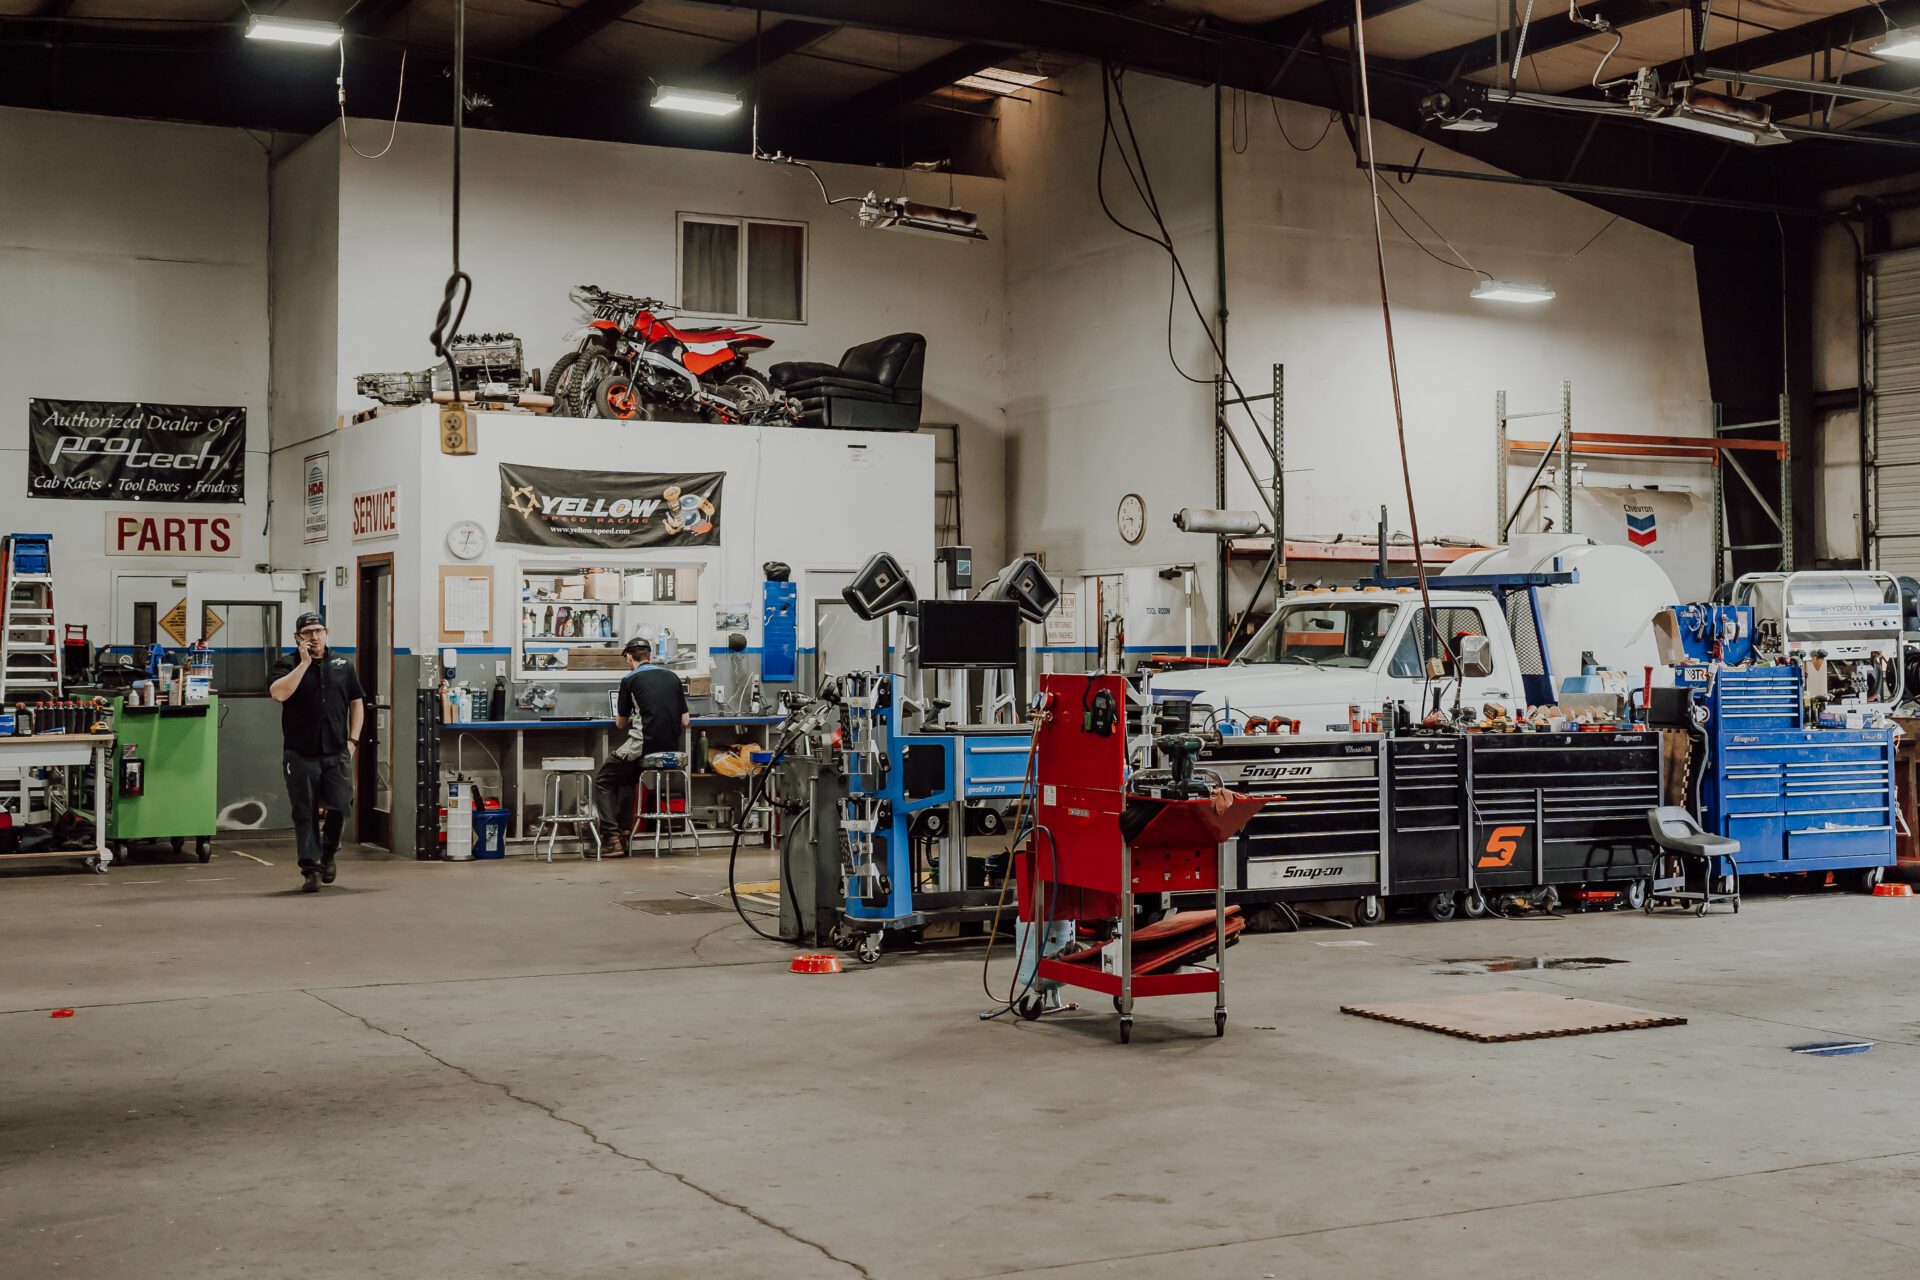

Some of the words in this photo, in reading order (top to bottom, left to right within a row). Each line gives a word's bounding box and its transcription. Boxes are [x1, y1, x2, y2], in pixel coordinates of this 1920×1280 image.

[43, 411, 144, 430] Authorized
[147, 415, 203, 432] Dealer
[207, 416, 236, 436] Of
[34, 475, 60, 489] Cab
[63, 476, 103, 490] Racks
[118, 478, 145, 491] Tool
[146, 479, 180, 493] Boxes
[194, 480, 238, 494] Fenders
[308, 481, 324, 497] HDA
[353, 491, 396, 535] SERVICE
[540, 495, 661, 518] YELLOW
[1623, 504, 1654, 513] Chevron
[117, 517, 231, 552] PARTS
[550, 526, 631, 536] www.yellow-speed.com
[1157, 607, 1170, 615] ROOM
[1240, 765, 1313, 779] Snap-on
[1282, 866, 1344, 879] Snap-on
